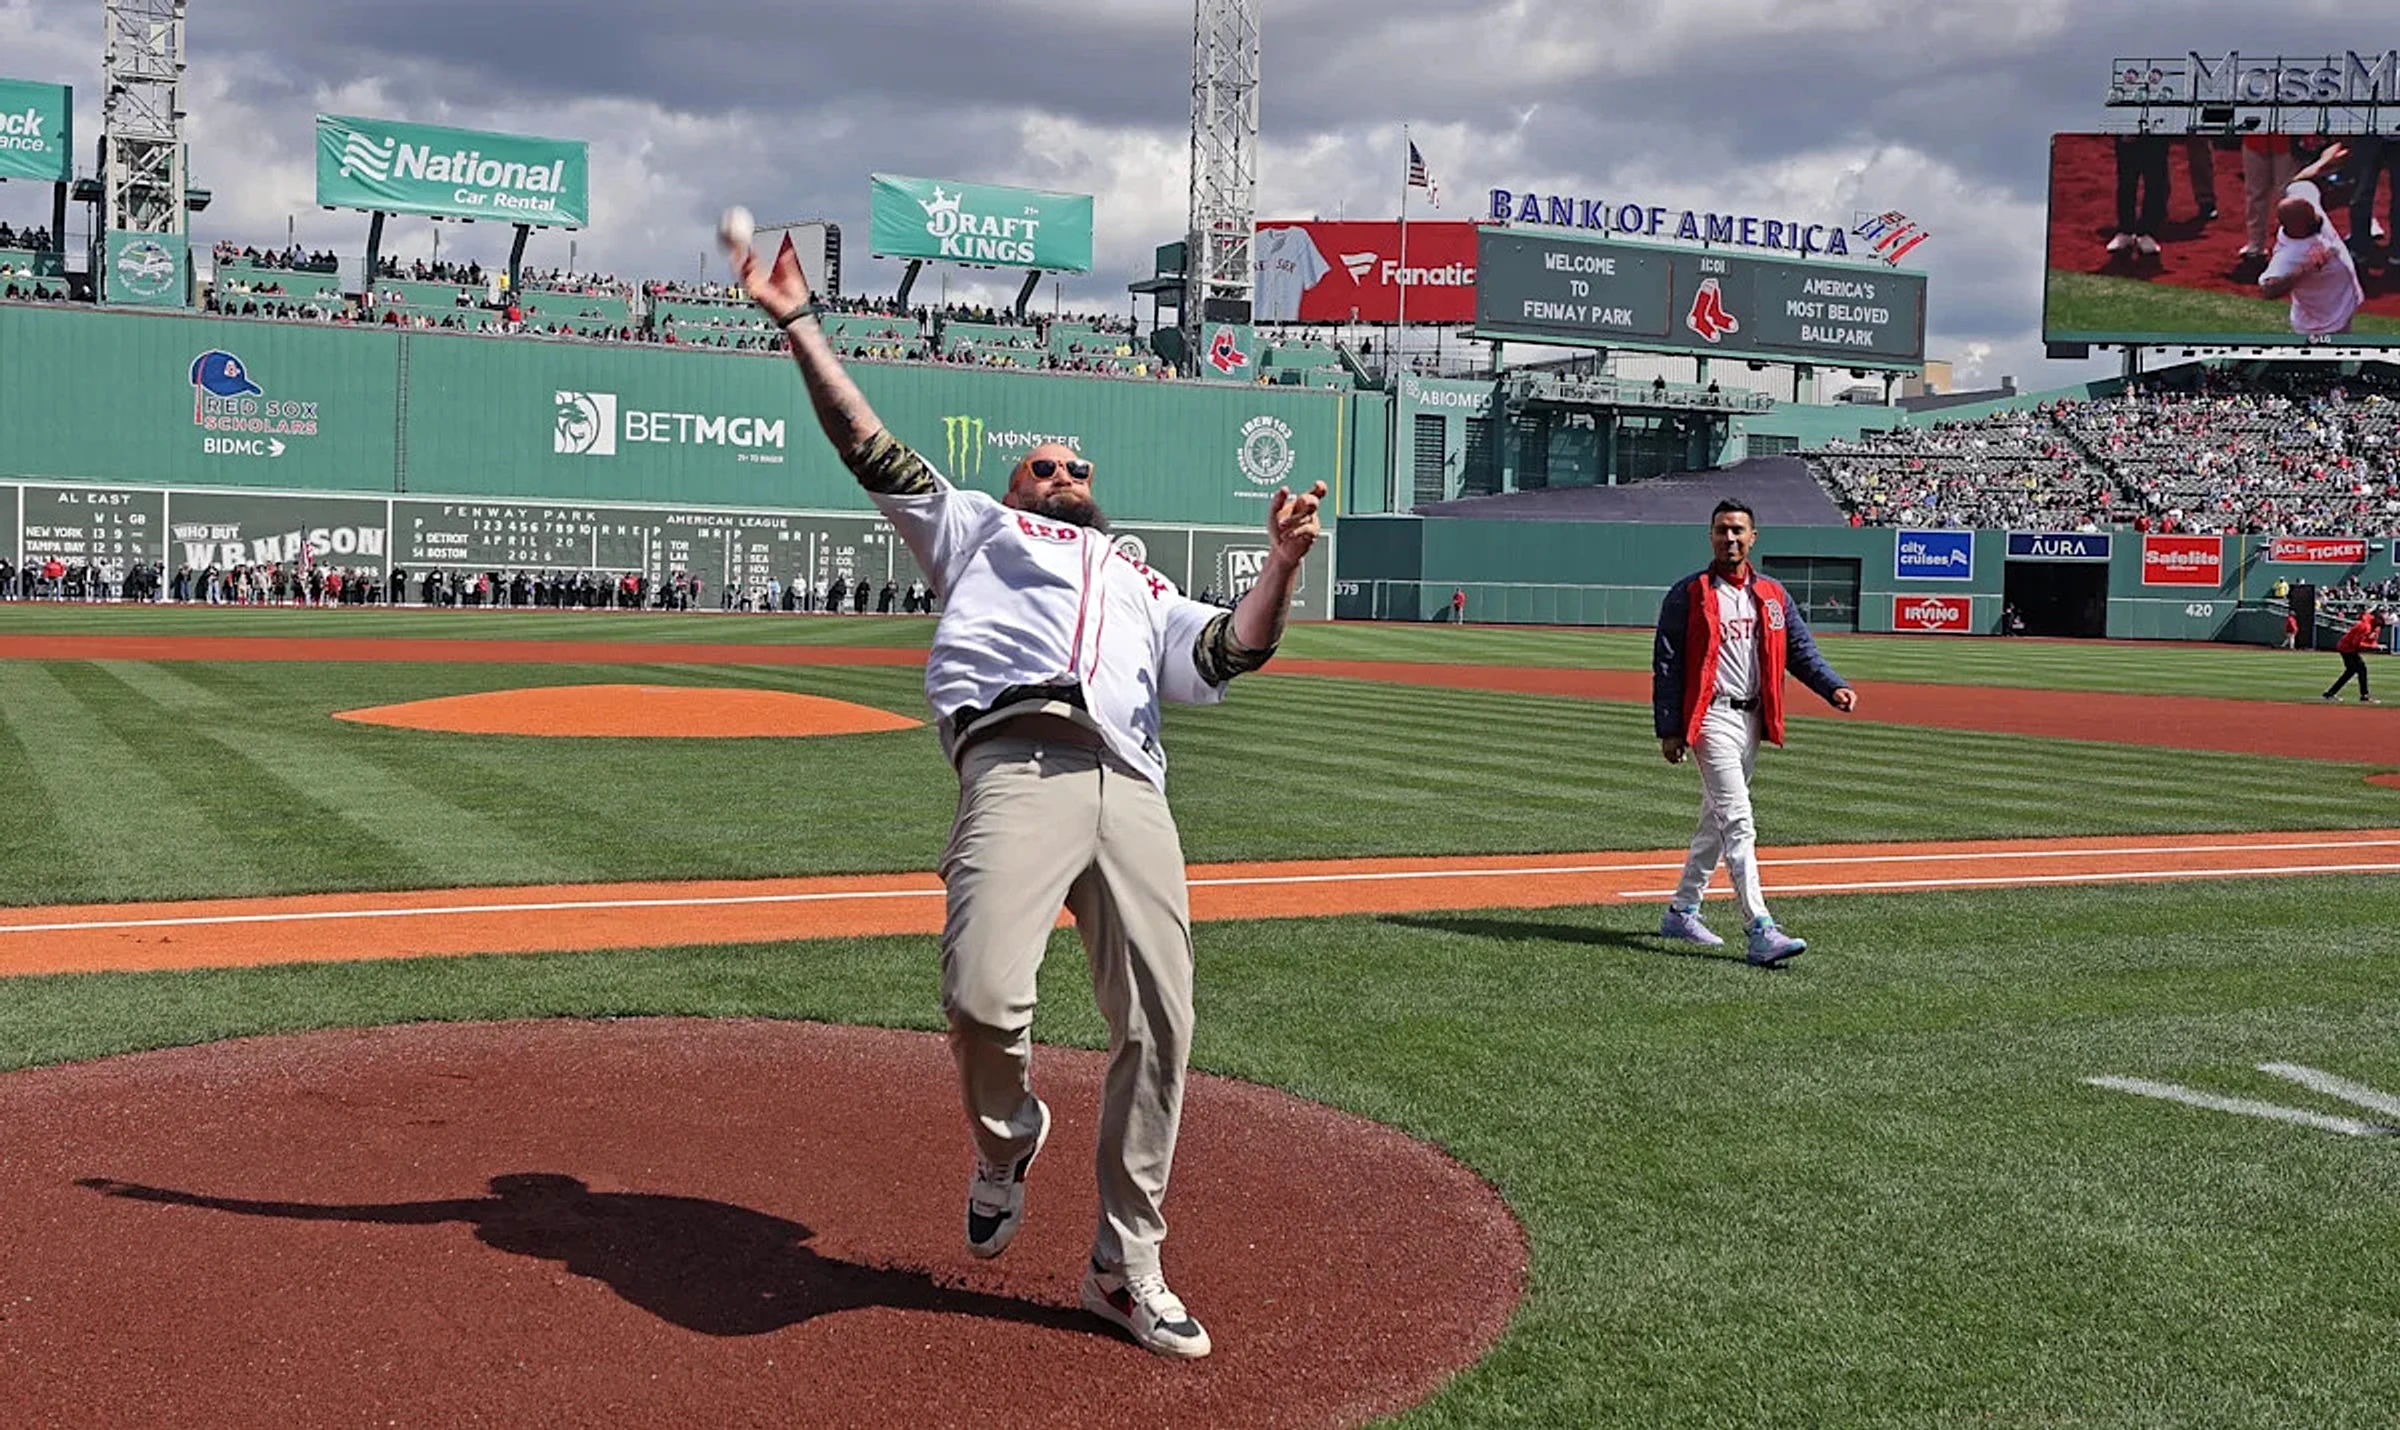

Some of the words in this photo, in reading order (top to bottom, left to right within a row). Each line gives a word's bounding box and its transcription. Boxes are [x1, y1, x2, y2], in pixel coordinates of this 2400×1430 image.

[2187, 50, 2400, 104] MassM
[394, 144, 564, 193] National
[454, 189, 487, 204] Car
[494, 192, 555, 212] Rental
[926, 208, 1040, 240] DRAFT
[1490, 189, 1605, 230] BANK
[1618, 204, 1667, 236] OF
[1678, 210, 1849, 256] AMERICA
[940, 234, 1036, 263] KINGS
[1545, 252, 1615, 275] WELCOME
[1570, 280, 1589, 297] TO
[1803, 278, 1875, 299] AMERICA'S
[1523, 300, 1587, 322] FENWAY
[1592, 306, 1632, 327] PARK
[1786, 300, 1824, 318] MOST
[1828, 304, 1889, 324] BELOVED
[1802, 324, 1873, 346] BALLPARK
[1420, 390, 1493, 409] ABIOMED
[205, 397, 257, 415] RED
[266, 400, 318, 419] SOX
[204, 416, 318, 435] SCHOLARS
[625, 410, 785, 448] BETMGM
[204, 437, 265, 456] BIDMC
[58, 492, 79, 503] AL
[88, 494, 131, 505] EAST
[94, 512, 105, 523] W
[114, 513, 123, 523] L
[129, 514, 146, 525] GB
[444, 506, 527, 518] FENWAY
[544, 510, 597, 521] PARK
[415, 518, 423, 529] P
[602, 525, 609, 535] R
[633, 526, 641, 536] E
[667, 515, 733, 527] AMERICAN
[739, 518, 788, 529] LEAGUE
[26, 526, 51, 537] NEW
[54, 527, 83, 539] YORK
[93, 528, 105, 539] 13
[114, 528, 123, 539] 9
[174, 525, 208, 539] WHO
[212, 526, 240, 540] BUT
[426, 533, 469, 544] DETROIT
[483, 536, 537, 547] APRIL
[653, 526, 661, 536] P
[733, 530, 742, 540] P
[821, 532, 829, 542] P
[25, 540, 61, 552] TAMPA
[64, 542, 85, 553] BAY
[93, 542, 106, 553] 12
[114, 542, 123, 553] 9
[670, 540, 689, 551] TOR
[836, 546, 855, 556] LAD
[1900, 541, 1926, 554] city
[2276, 543, 2305, 555] ACE
[2307, 544, 2363, 561] TICKET
[427, 549, 468, 559] BOSTON
[670, 552, 689, 561] LAA
[749, 554, 769, 563] SEA
[835, 556, 854, 566] COL
[1900, 555, 1949, 565] cruises
[2145, 550, 2220, 566] Safelite
[749, 564, 769, 573] HOU
[1904, 607, 1959, 621] IRVING
[2185, 604, 2213, 617] 420
